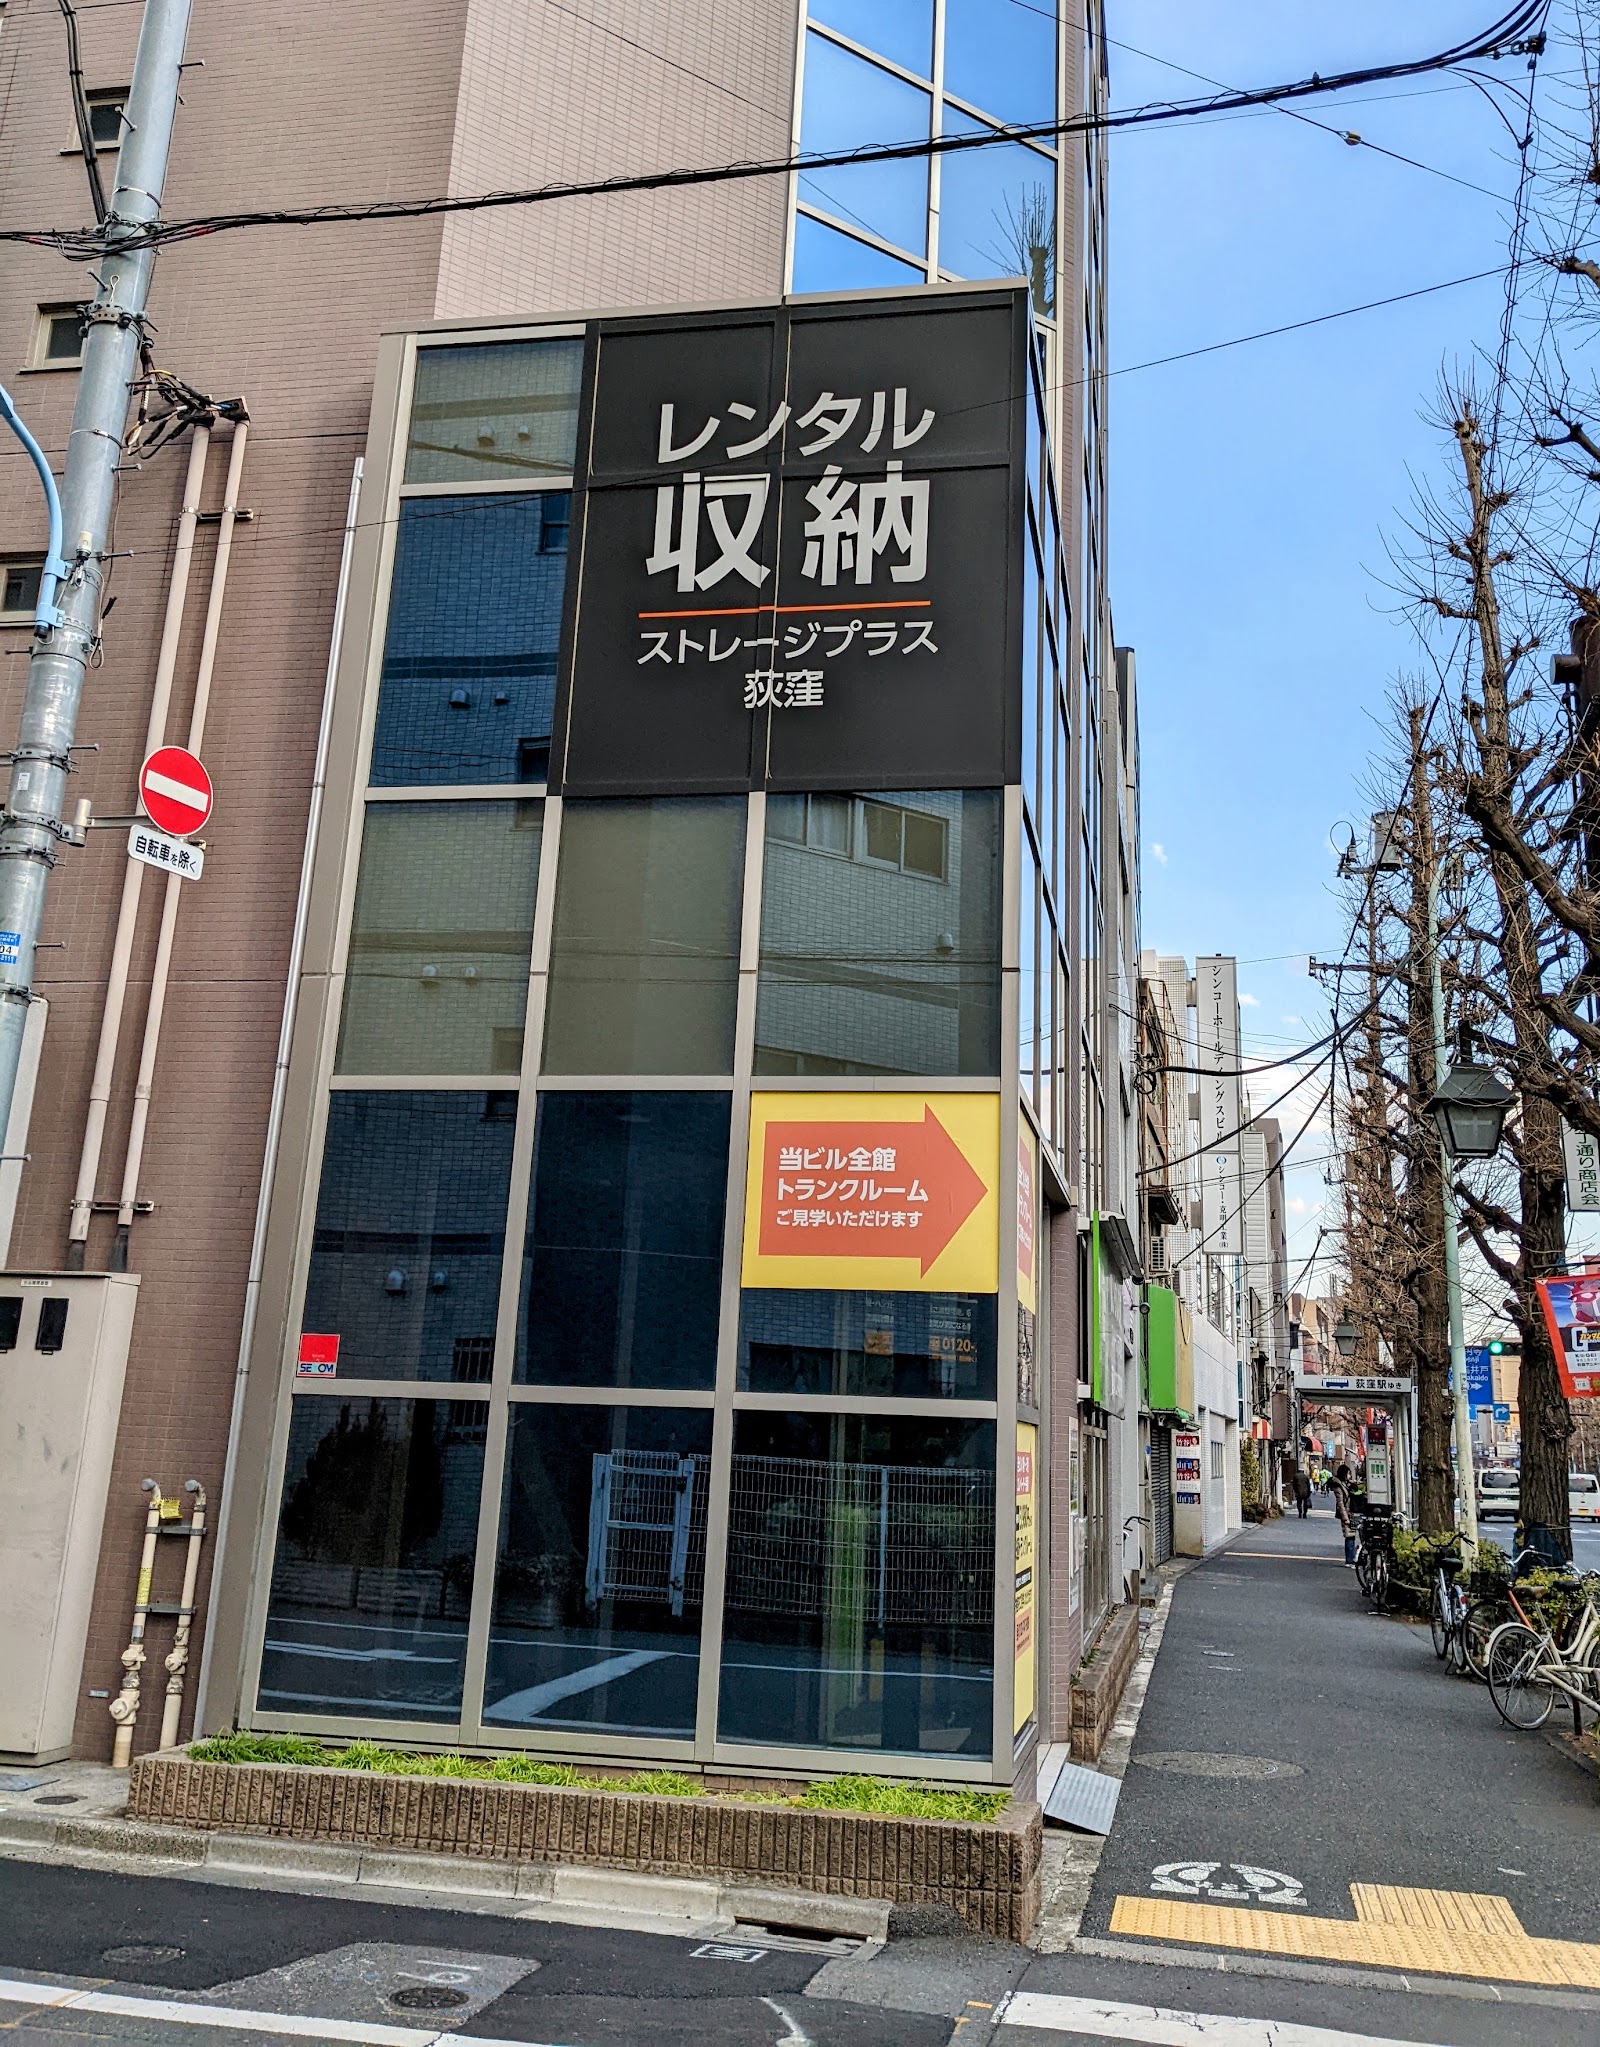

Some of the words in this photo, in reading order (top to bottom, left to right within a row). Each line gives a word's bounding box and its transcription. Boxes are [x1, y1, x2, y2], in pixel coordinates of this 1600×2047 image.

[658, 388, 935, 463] レンタル
[646, 460, 930, 592] 収納
[637, 619, 938, 664] ストレージプラス
[744, 669, 824, 708] 荻窪
[135, 834, 196, 873] 自転車を除く
[778, 1147, 896, 1172] 当ビル全館
[777, 1178, 929, 1202] トランクルーム
[776, 1210, 923, 1228] ご見学いただけます
[1355, 1378, 1403, 1390] 荻窪駅ゆき
